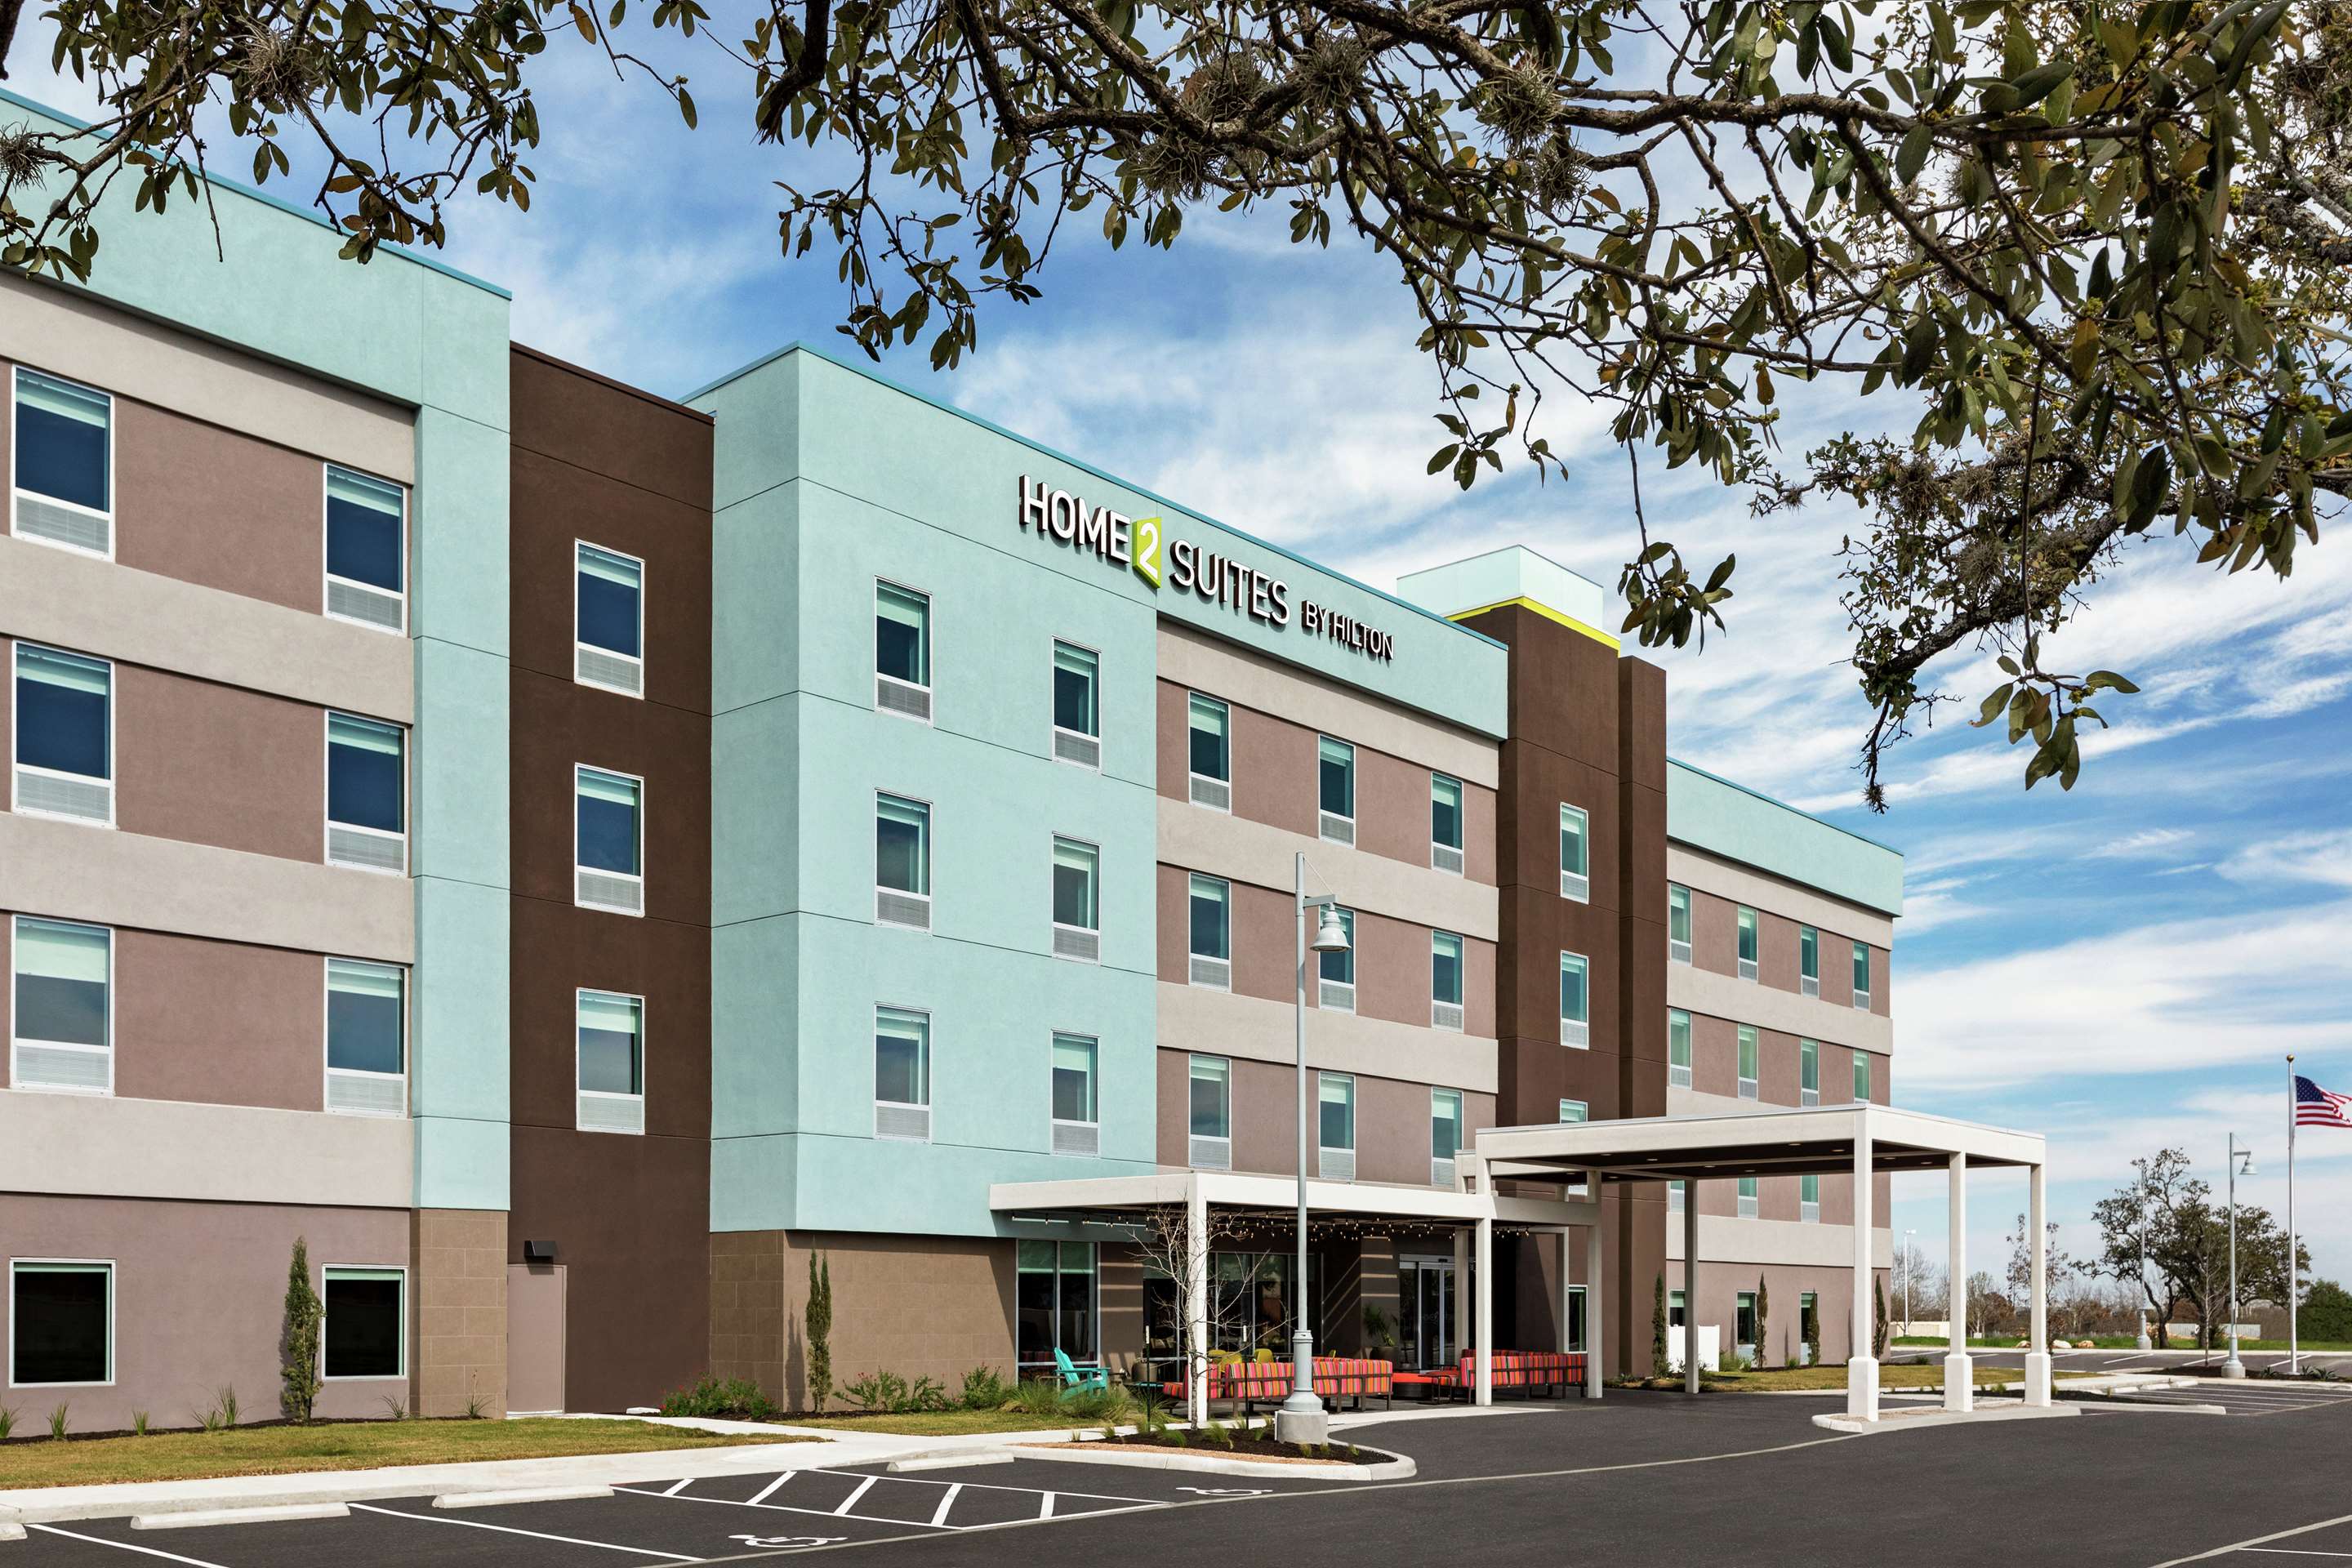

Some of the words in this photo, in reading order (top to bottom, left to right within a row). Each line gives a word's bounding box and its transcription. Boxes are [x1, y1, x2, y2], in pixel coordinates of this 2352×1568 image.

[1169, 540, 1290, 625] SUITES
[1302, 600, 1329, 632] BY
[1329, 612, 1394, 660] HILTON
